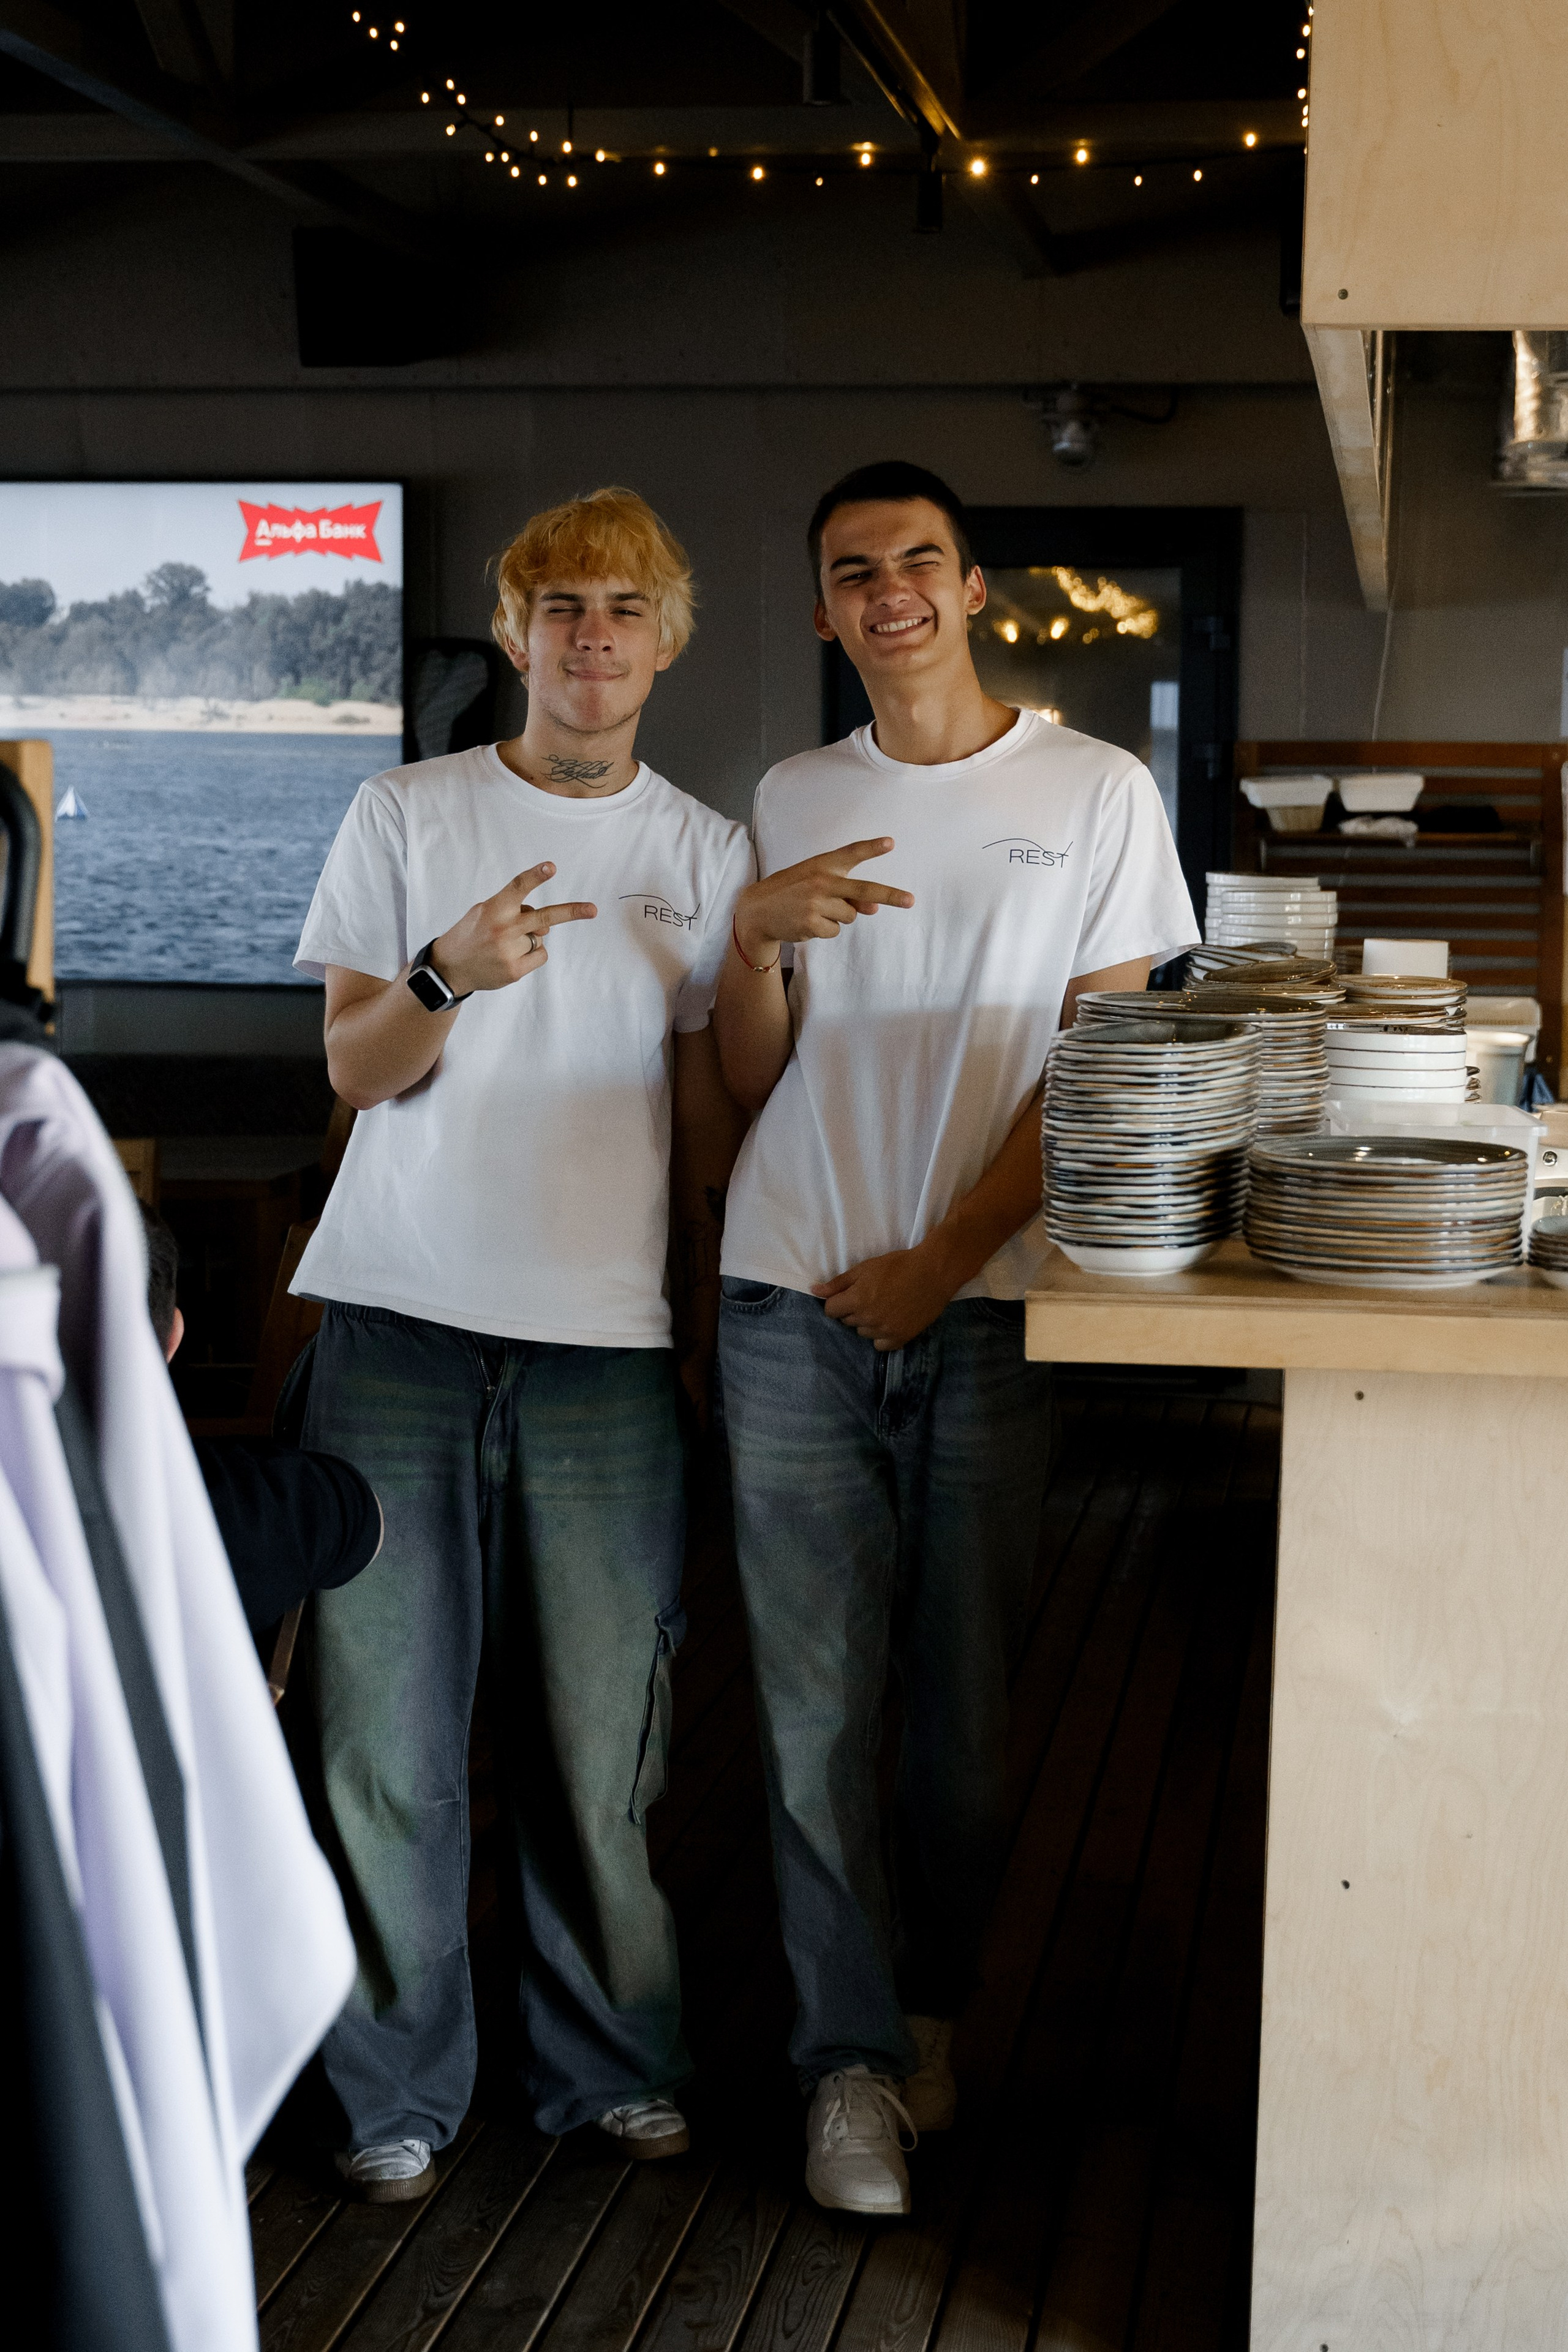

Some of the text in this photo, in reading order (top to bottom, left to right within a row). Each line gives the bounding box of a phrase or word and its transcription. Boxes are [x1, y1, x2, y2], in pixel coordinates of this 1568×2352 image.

[254, 519, 366, 546] Альфа Банк
[1009, 849, 1069, 868] REST
[644, 905, 698, 930] REST
